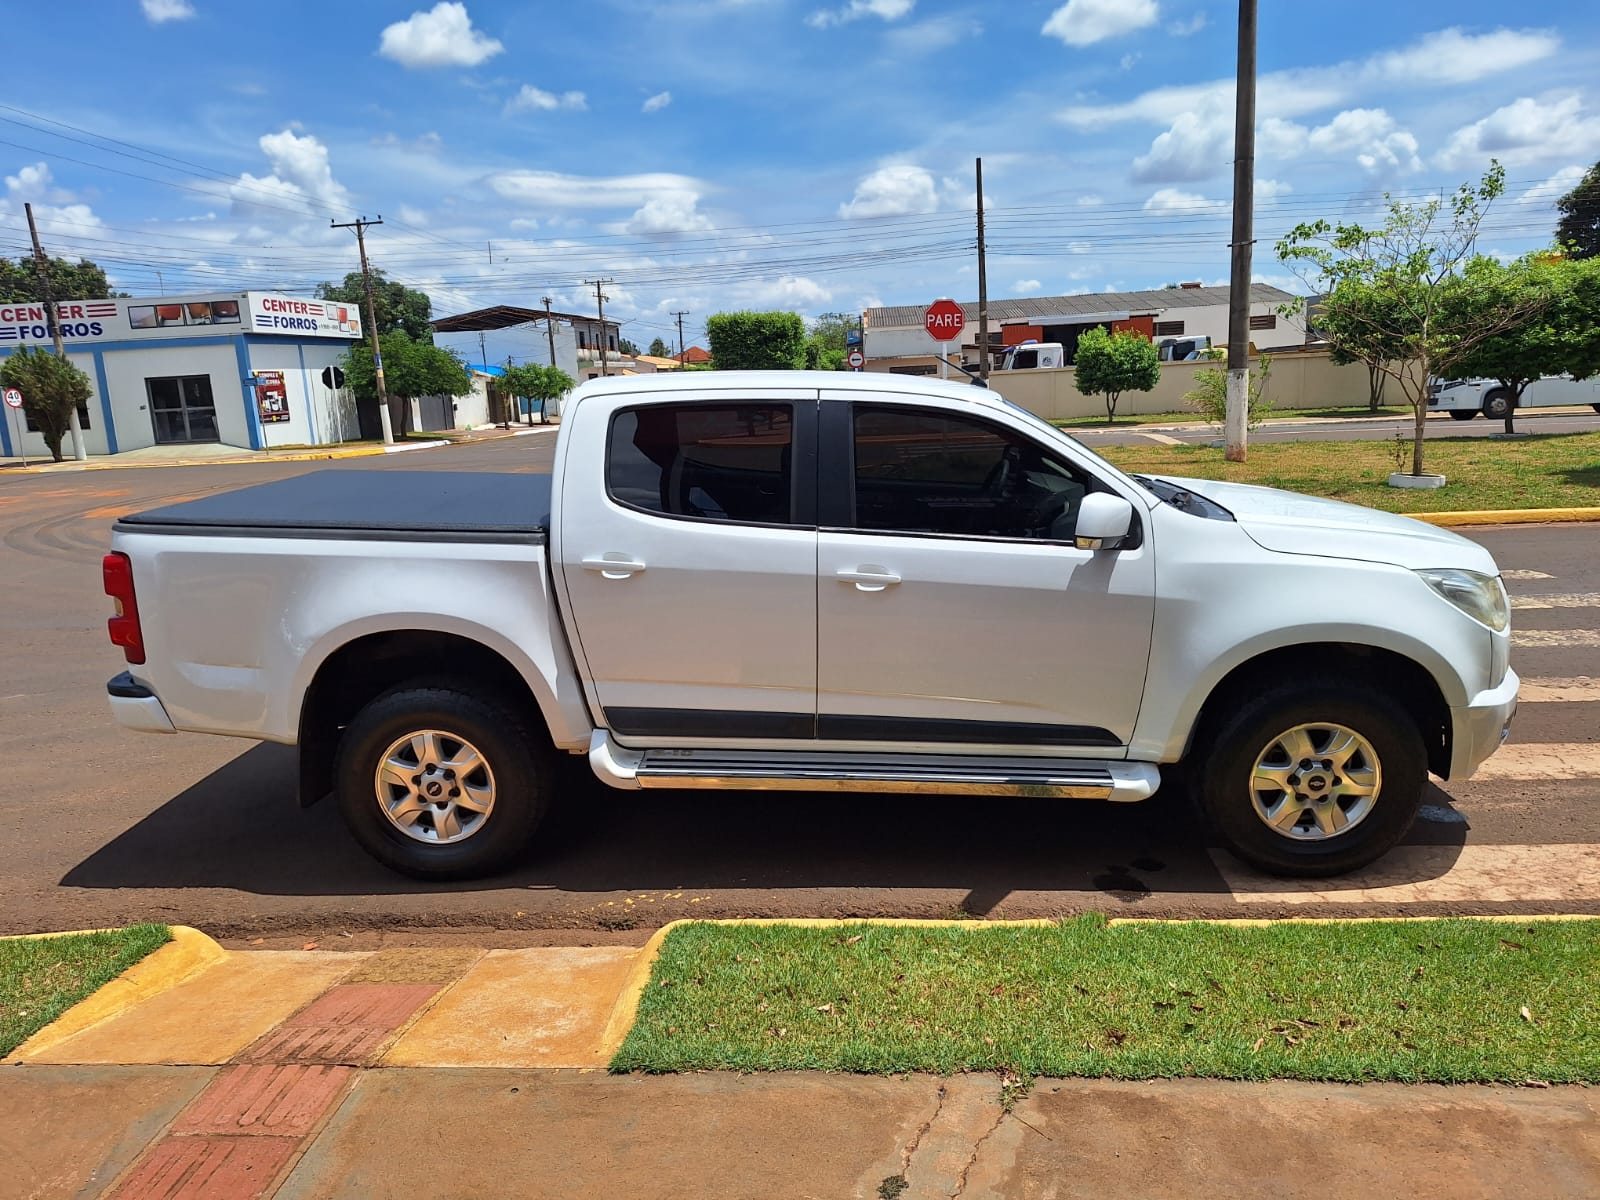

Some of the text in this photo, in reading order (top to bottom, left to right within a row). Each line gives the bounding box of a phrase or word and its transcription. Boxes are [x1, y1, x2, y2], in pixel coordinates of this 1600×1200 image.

[1, 305, 84, 322] CENER
[263, 299, 308, 314] CENTER
[273, 316, 318, 331] FORROS
[927, 313, 962, 327] PARE
[7, 391, 20, 400] 40
